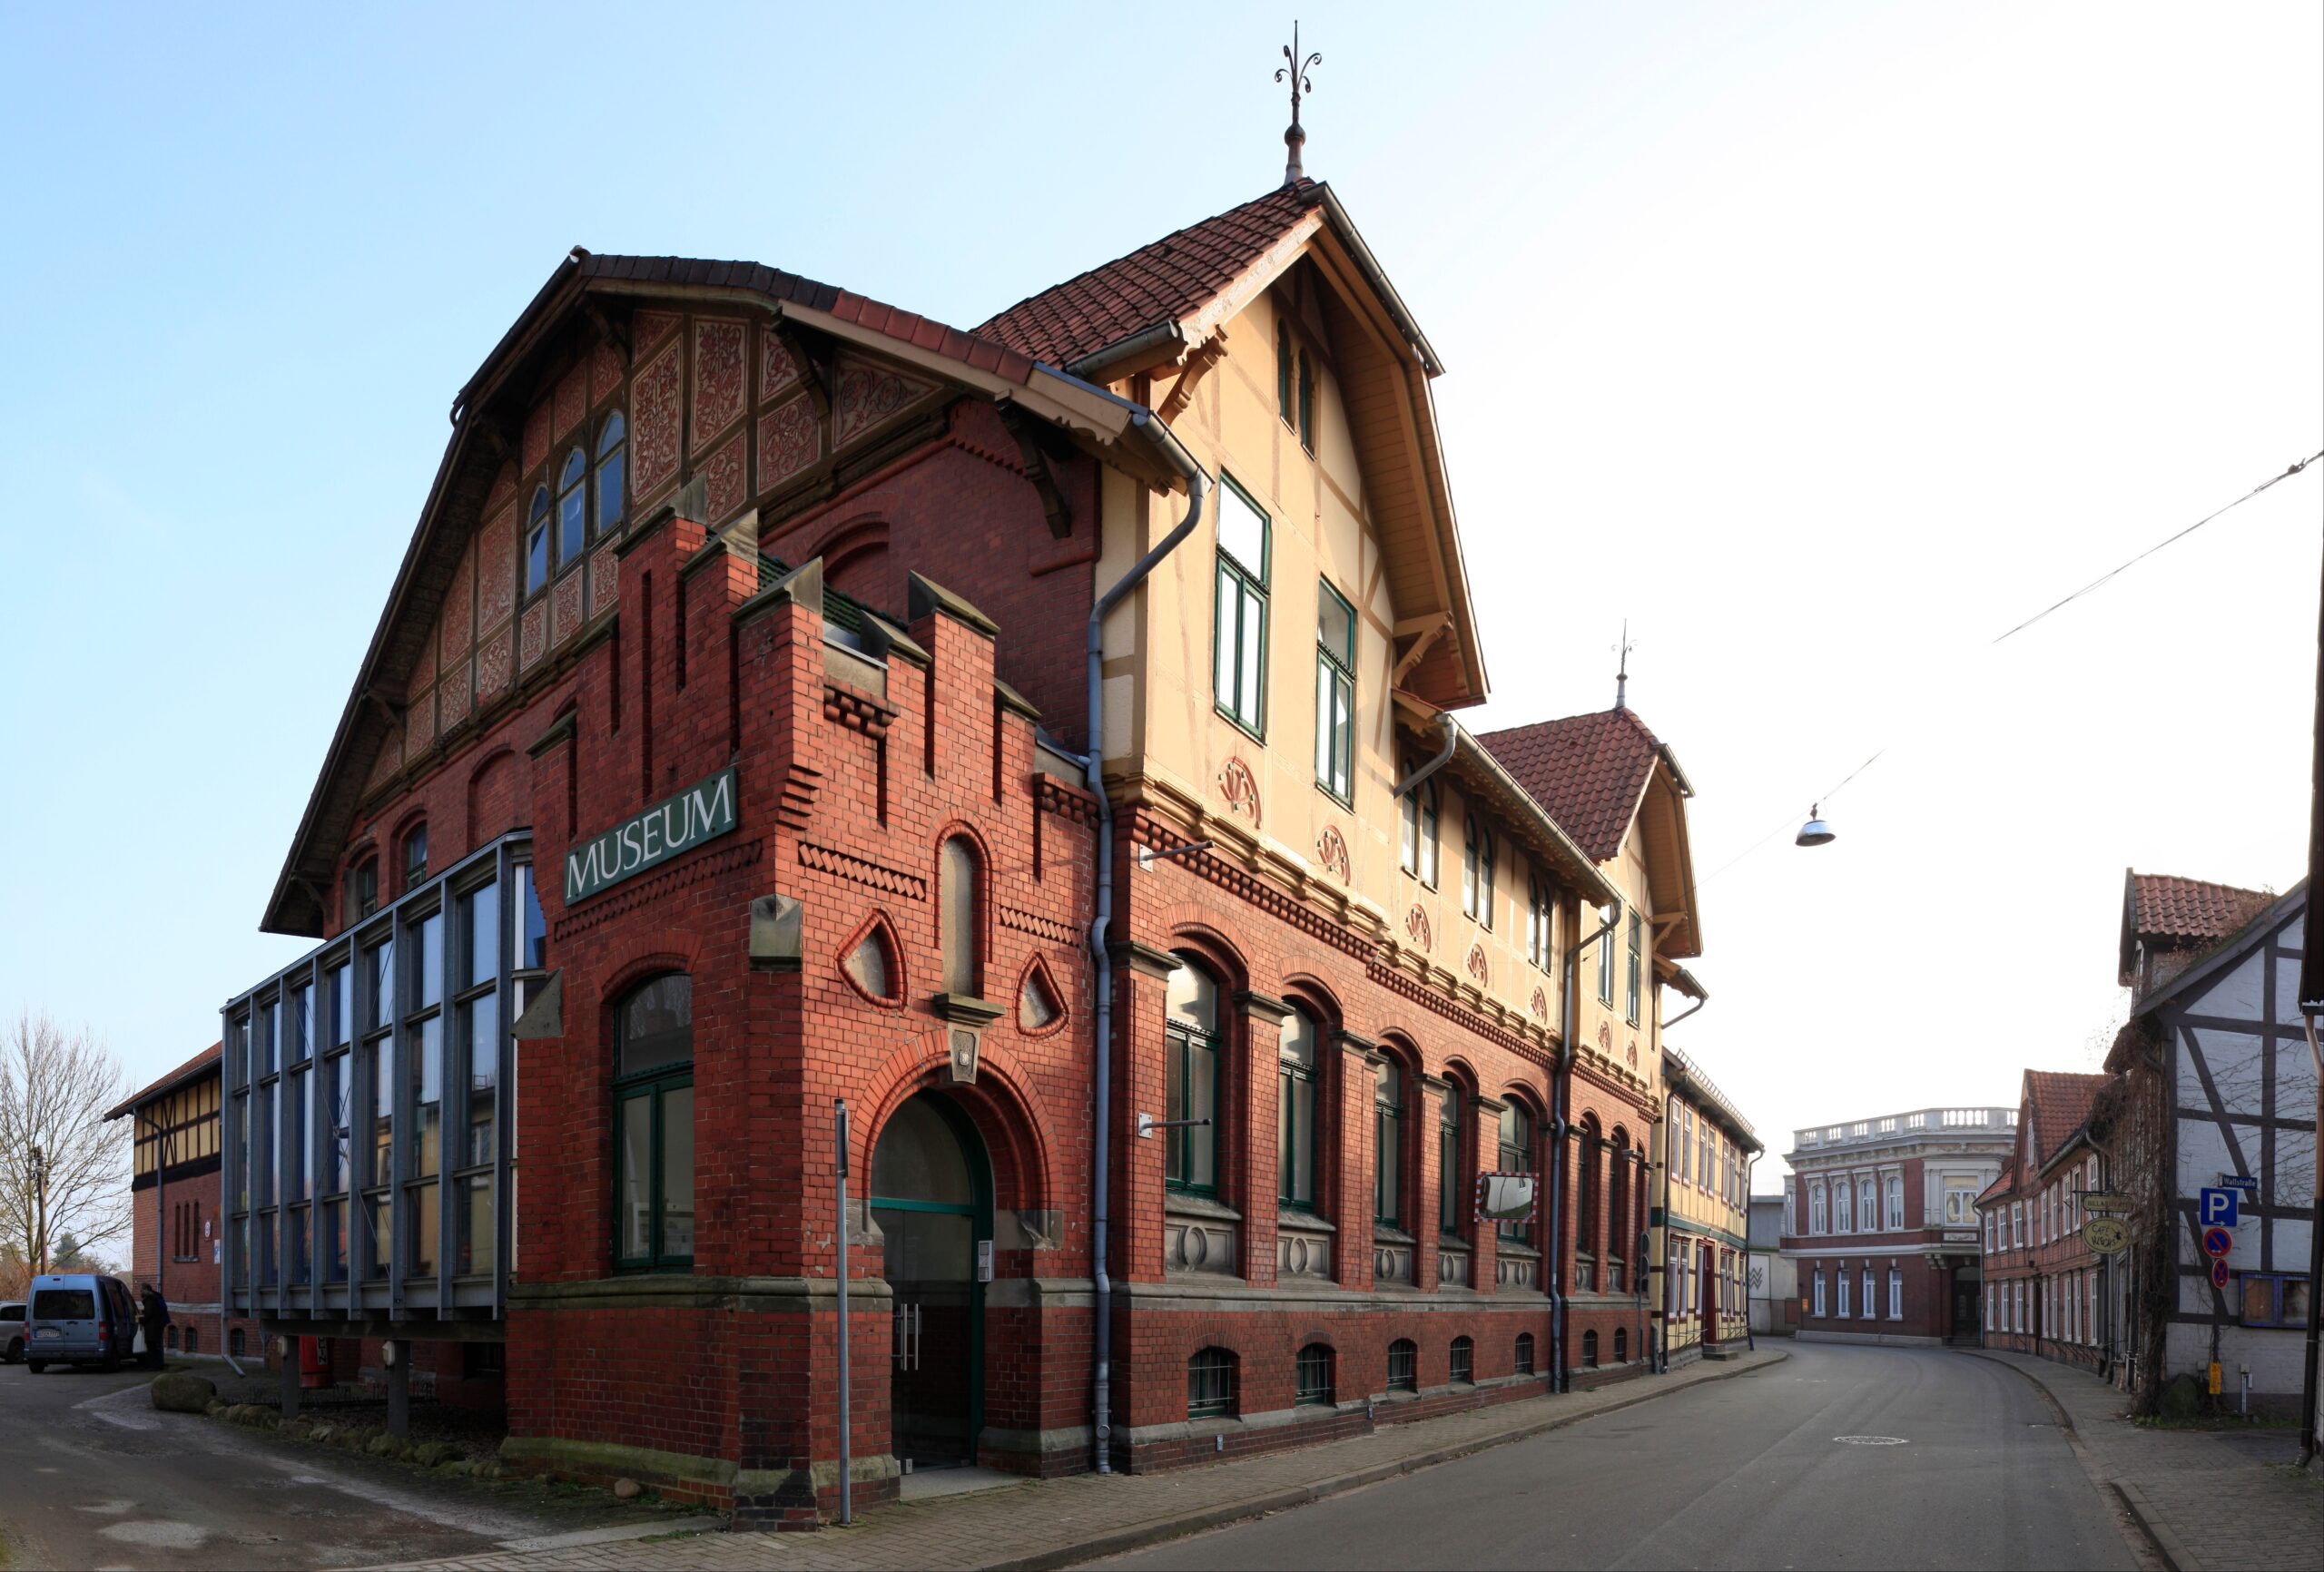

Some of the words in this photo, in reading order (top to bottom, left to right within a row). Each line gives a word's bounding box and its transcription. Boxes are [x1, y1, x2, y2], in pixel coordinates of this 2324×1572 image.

[566, 774, 733, 899] MUSEUM
[2223, 1177, 2256, 1187] Wallstraße
[2209, 1193, 2230, 1222] P
